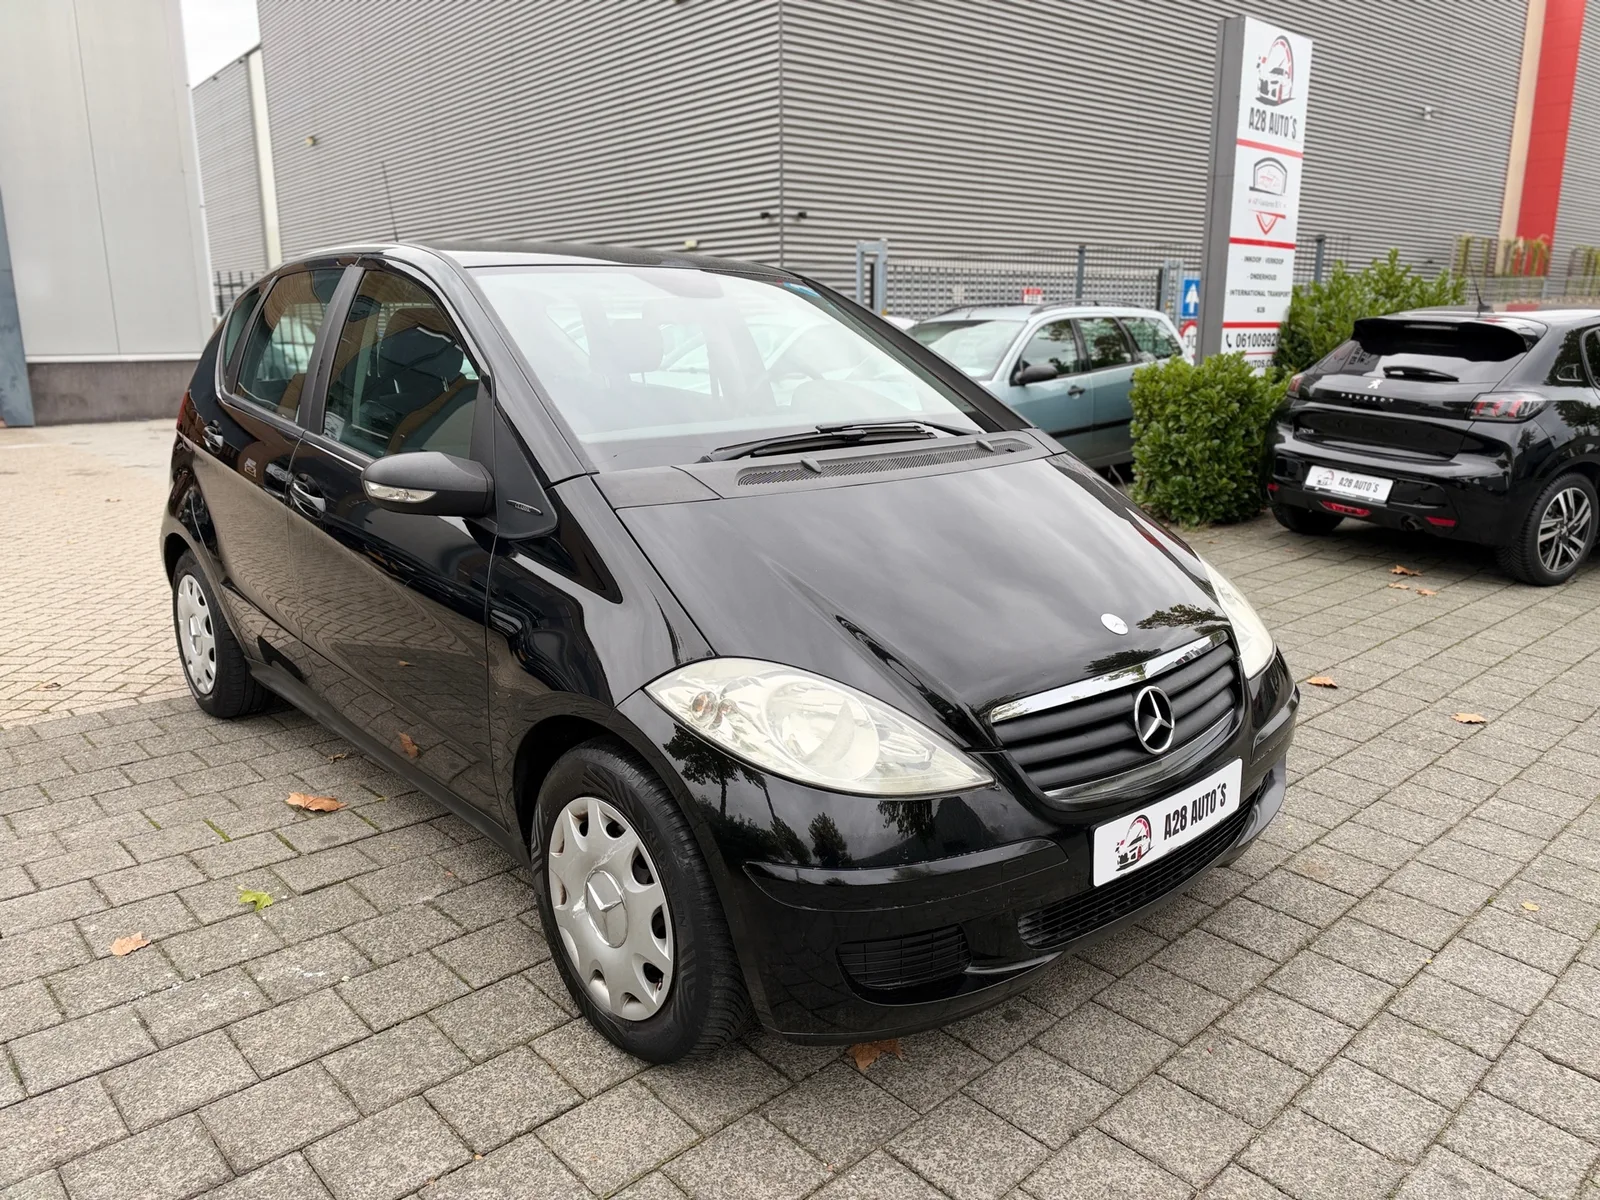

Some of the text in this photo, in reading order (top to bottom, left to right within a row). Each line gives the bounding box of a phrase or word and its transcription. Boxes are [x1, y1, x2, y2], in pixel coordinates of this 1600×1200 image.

[1248, 107, 1267, 133] A28
[1229, 289, 1291, 298] INTERNATIONAL TRANSPORT
[1340, 392, 1394, 403] PEUGEOT
[1163, 805, 1188, 840] A28
